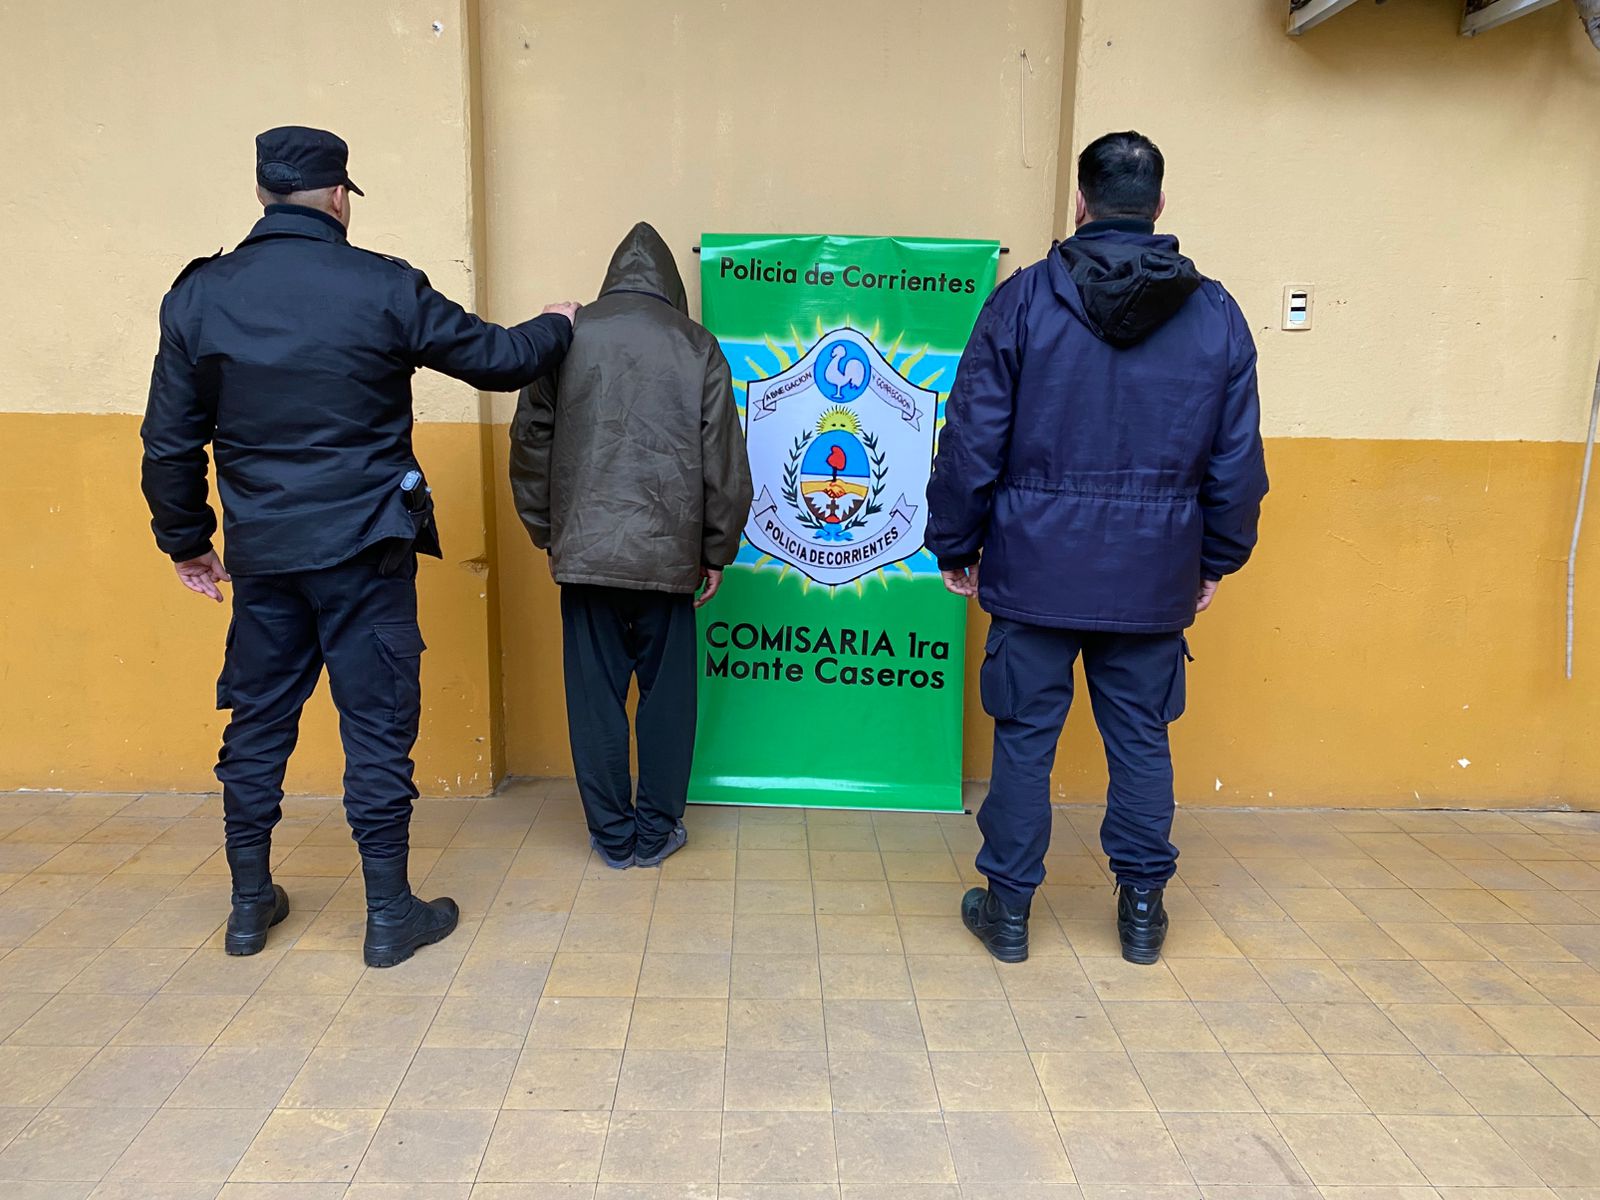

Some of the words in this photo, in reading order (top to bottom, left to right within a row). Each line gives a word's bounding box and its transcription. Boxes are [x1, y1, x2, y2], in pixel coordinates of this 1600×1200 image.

[720, 256, 797, 284] Policia
[804, 262, 835, 286] de
[842, 265, 976, 294] Corrientes
[765, 371, 813, 401] ABNEGACION
[764, 519, 807, 560] POLICIA
[809, 551, 825, 564] DE
[826, 526, 899, 565] CORRIENTES
[706, 621, 896, 657] COMISARIA
[908, 632, 949, 660] 1ra
[705, 650, 804, 682] Monte
[814, 657, 945, 689] Caseros
